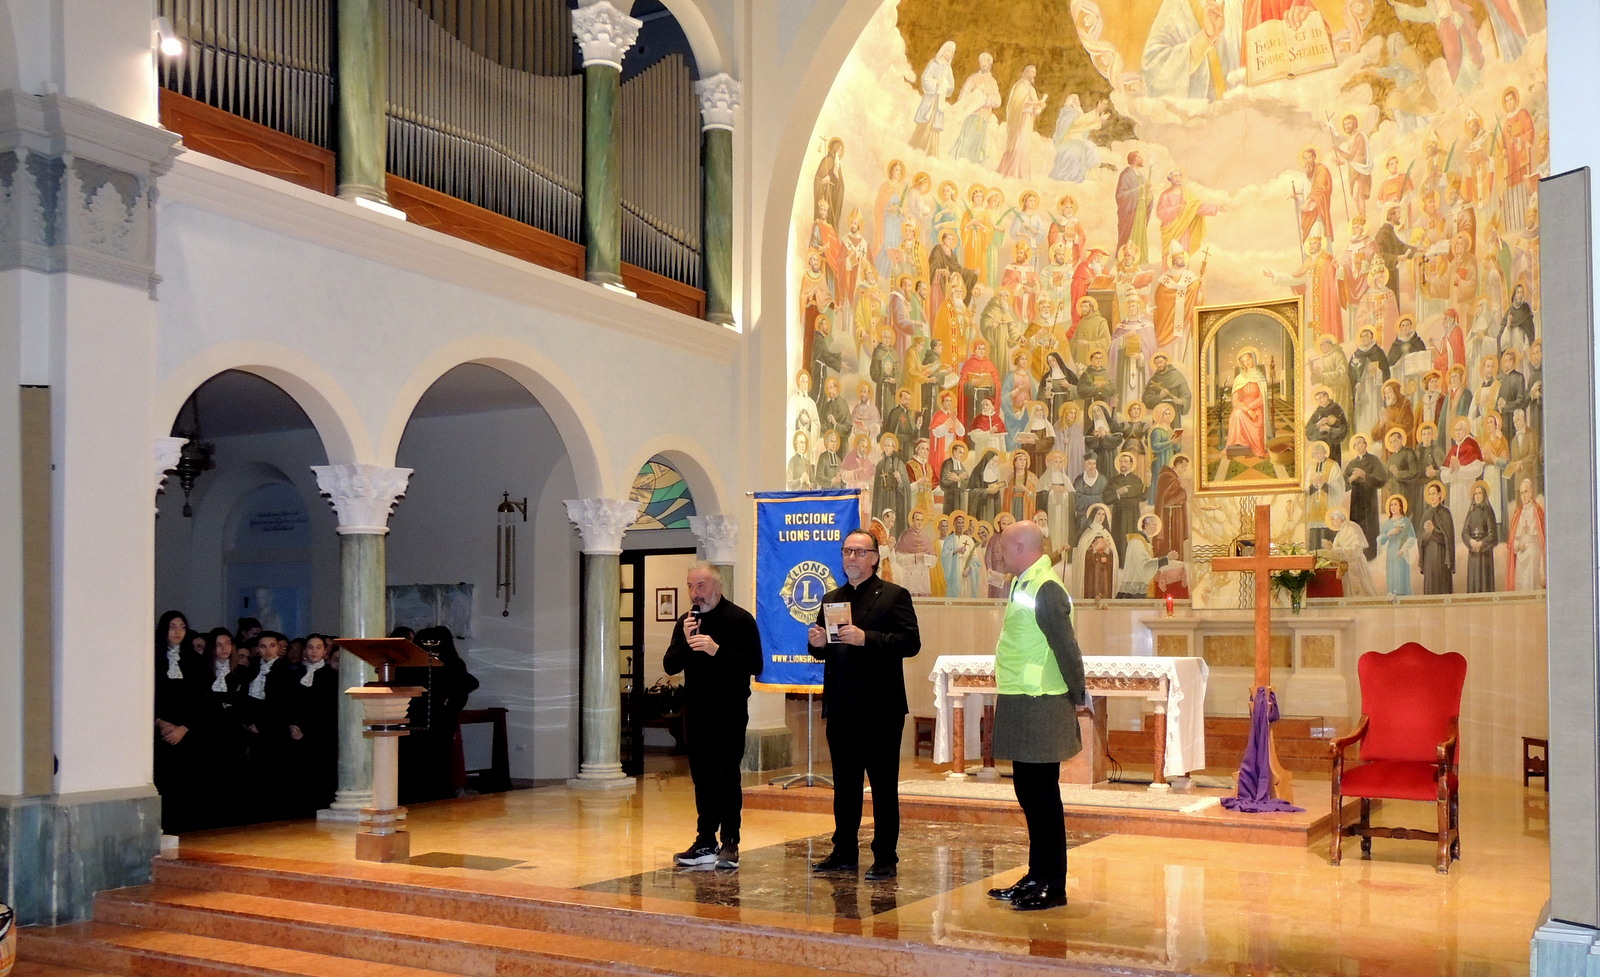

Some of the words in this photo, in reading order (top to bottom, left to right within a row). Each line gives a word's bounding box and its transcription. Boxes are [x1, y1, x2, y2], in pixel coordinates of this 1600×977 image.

[785, 513, 836, 525] RICCIONE
[779, 530, 810, 542] LIONS
[813, 529, 841, 541] CLUB
[792, 562, 828, 577] LIONS
[801, 580, 818, 603] L
